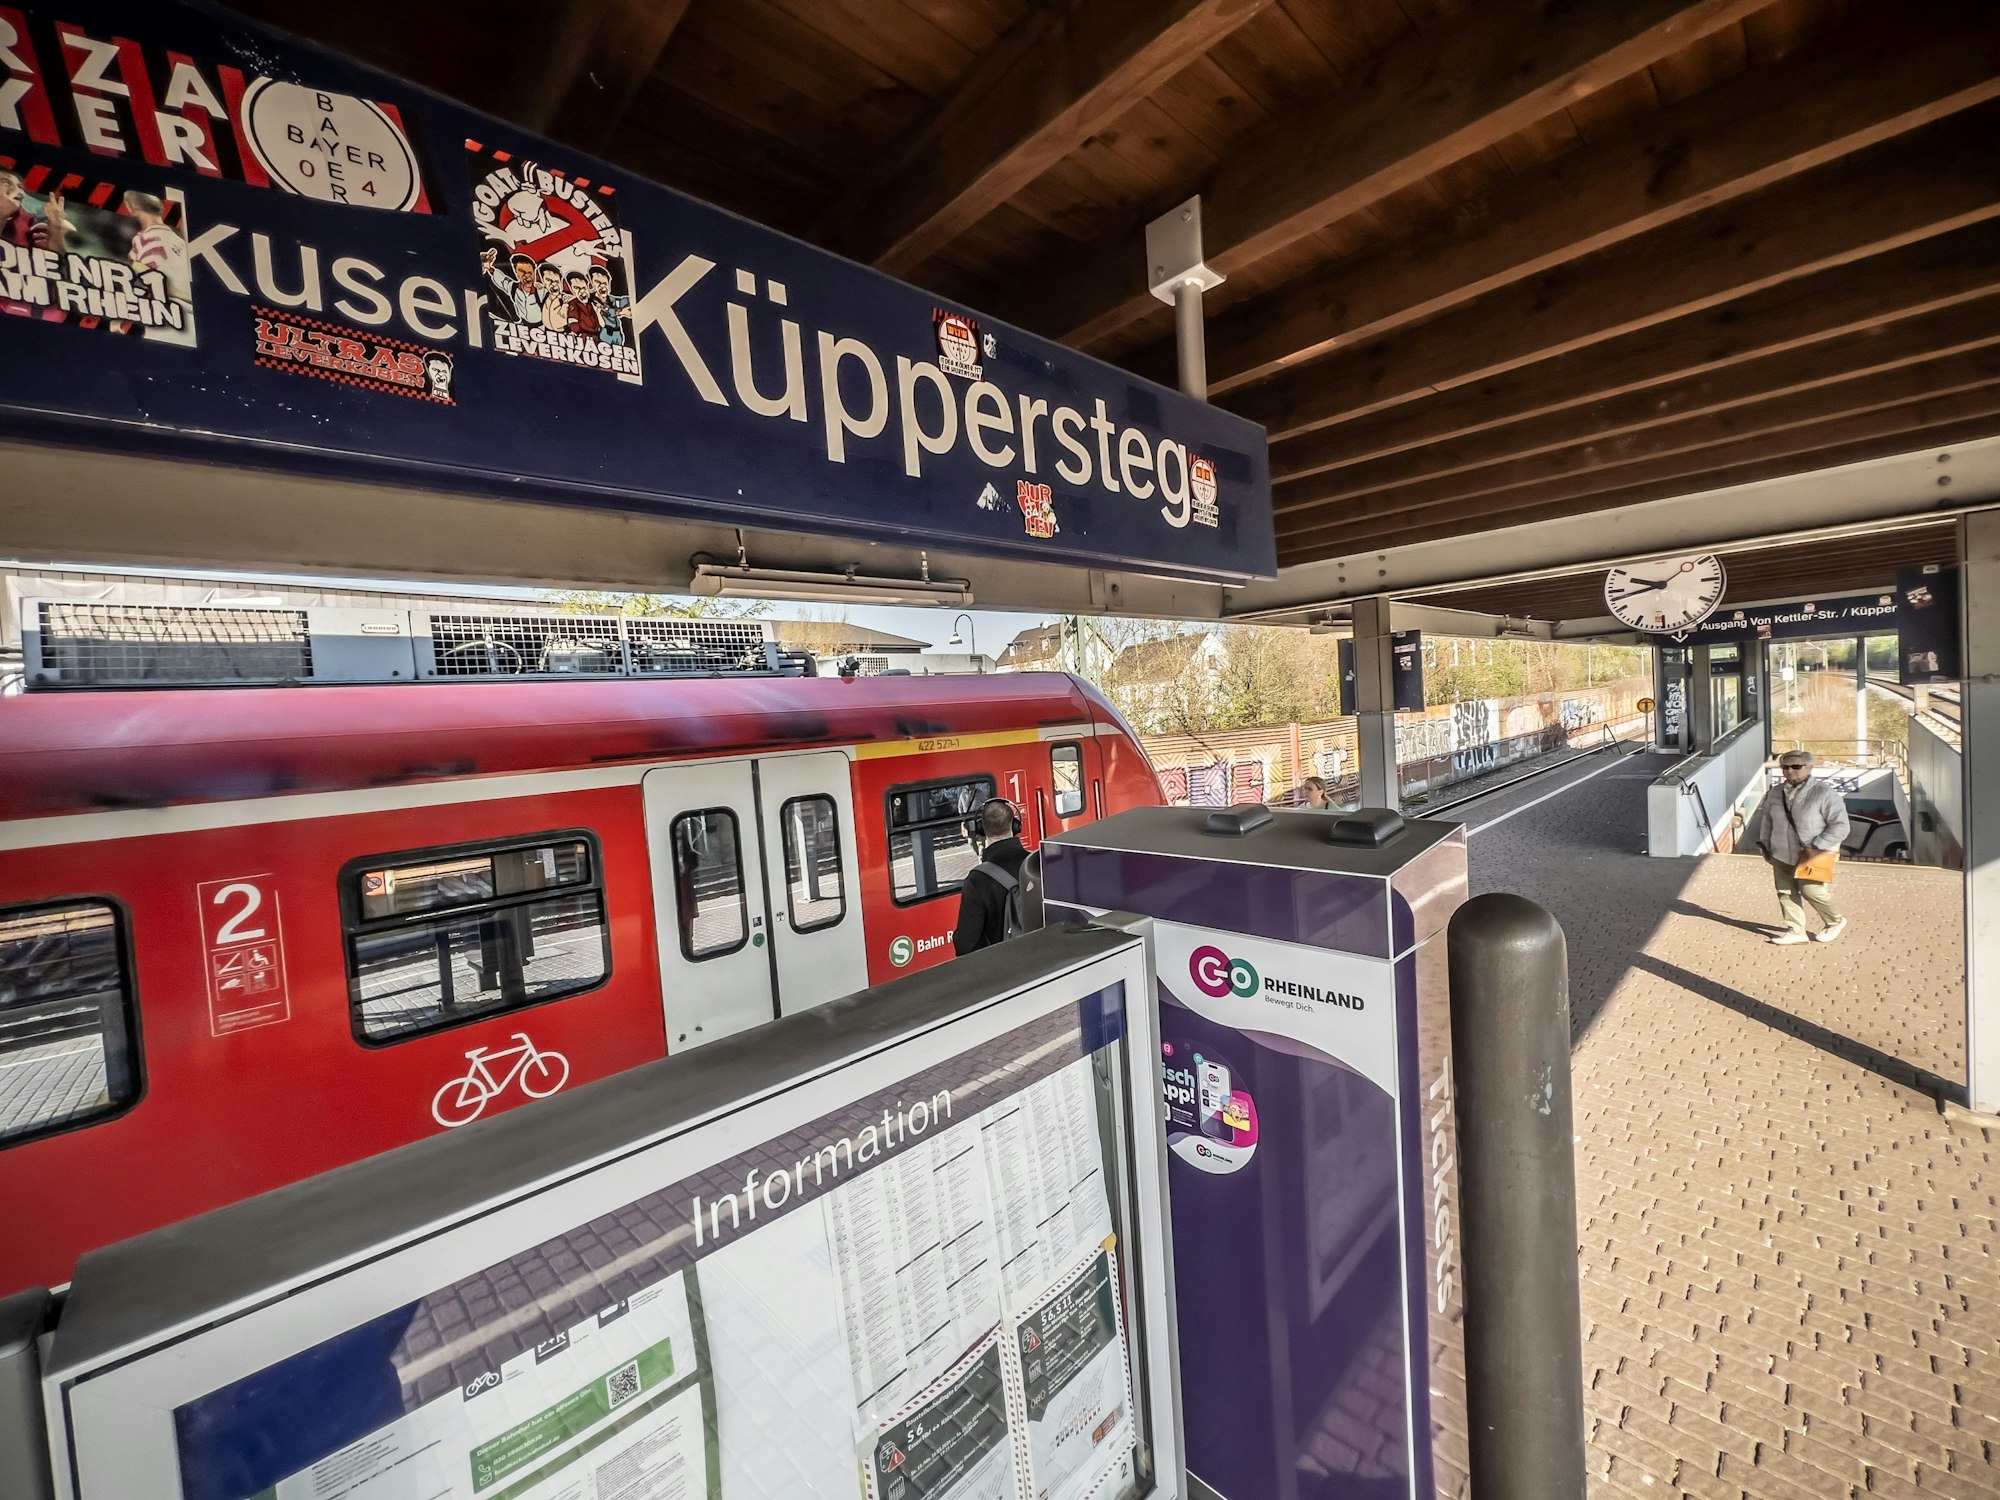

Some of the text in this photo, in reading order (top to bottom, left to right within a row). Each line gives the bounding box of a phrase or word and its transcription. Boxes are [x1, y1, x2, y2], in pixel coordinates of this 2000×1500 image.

[287, 123, 387, 172] BAYER
[316, 92, 350, 204] BAYER
[472, 167, 625, 258] GOAT BUSTERS
[0, 267, 182, 330] M RHEIN
[255, 318, 425, 375] ULTRAS
[493, 320, 637, 362] ZIEGENJÄGER
[494, 333, 640, 375] LEVERKUSEN
[255, 340, 426, 388] LEVERKUSEN
[619, 228, 1191, 528] Küppersteg
[1017, 480, 1052, 505] NUR
[1700, 618, 1748, 632] Ausgang
[1750, 616, 1771, 627] Von
[1774, 609, 1839, 624] Kettler-Str.
[918, 739, 935, 752] 422
[1009, 772, 1021, 803] 1
[213, 883, 265, 945] 2
[892, 938, 910, 964] S
[917, 935, 945, 953] Bahn
[1264, 977, 1365, 1011] RHEINLAND
[1264, 995, 1316, 1014] Bewegt Dich.
[691, 1089, 952, 1248] Information
[1429, 1055, 1456, 1314] Tickets
[1120, 1462, 1128, 1480] 2
